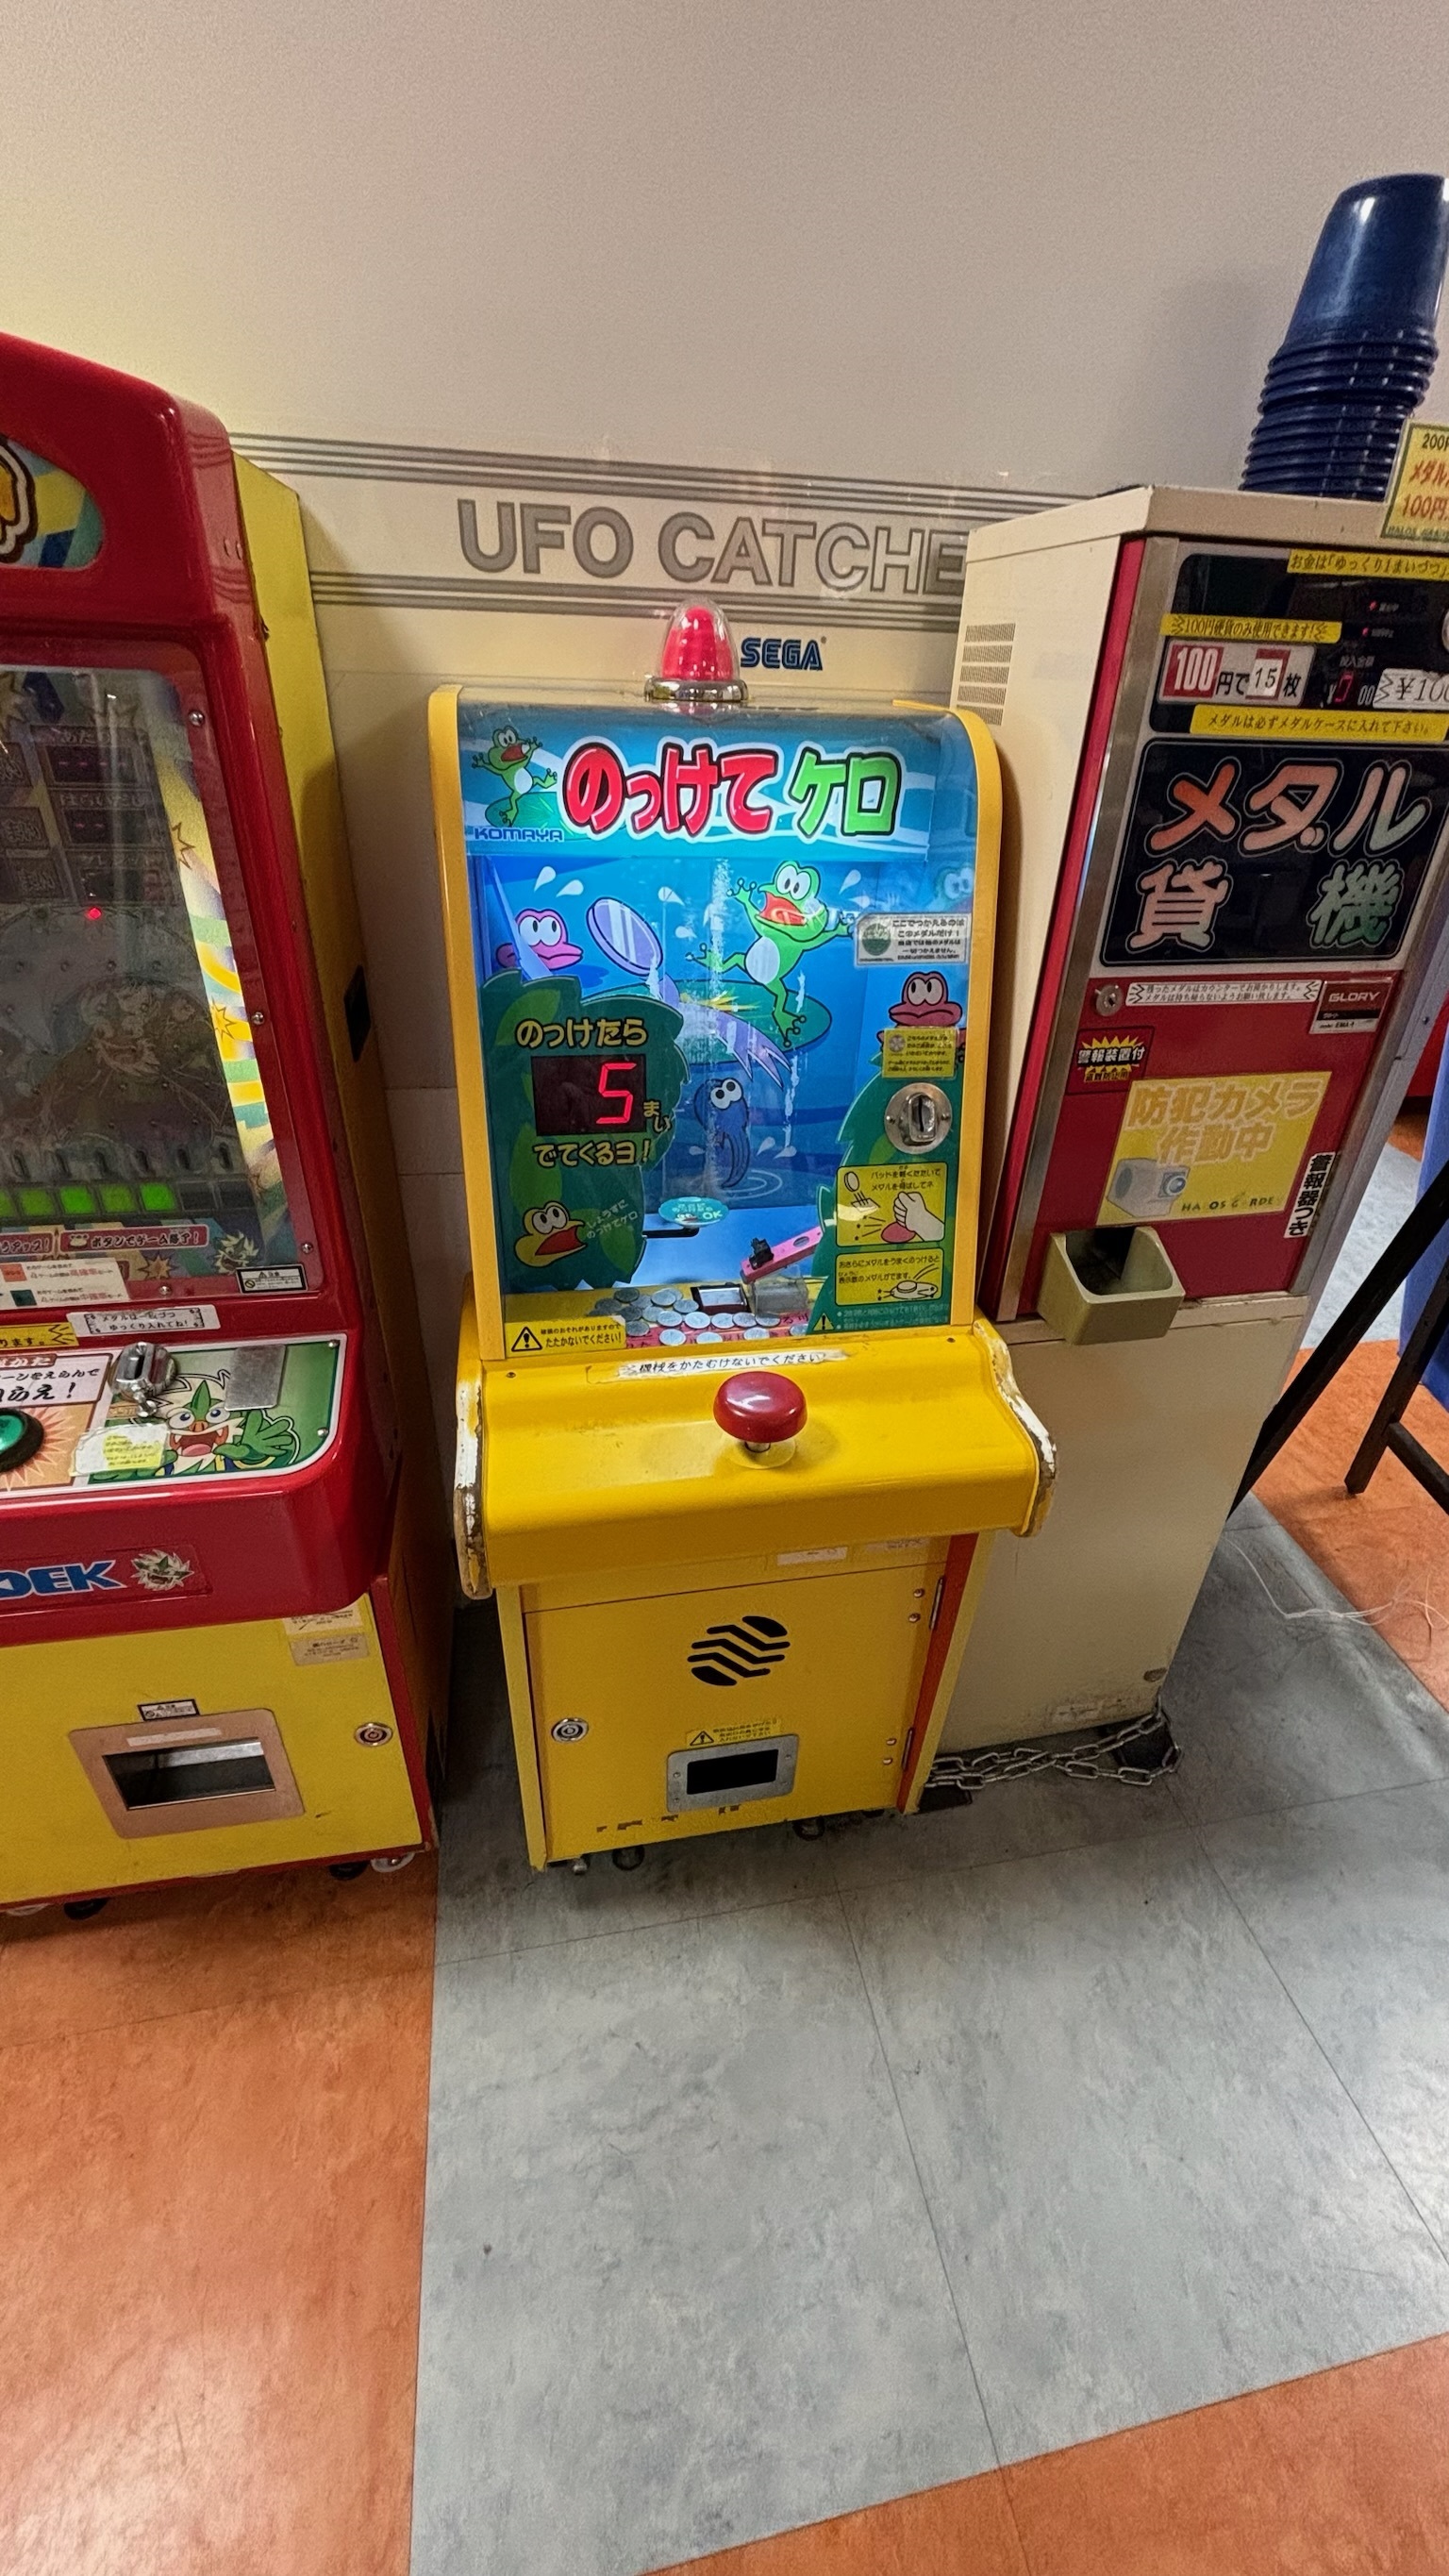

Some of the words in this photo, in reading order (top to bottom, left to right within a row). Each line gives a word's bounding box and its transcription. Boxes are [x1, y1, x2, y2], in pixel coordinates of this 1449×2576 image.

[1423, 432, 1449, 450] 200
[1409, 459, 1449, 485] メダル
[1401, 493, 1449, 522] 100円
[458, 498, 634, 578] UFO
[741, 637, 824, 671] SEGA
[565, 742, 777, 835] のっけて
[789, 746, 902, 837] ケロ
[1149, 762, 1429, 852] メダル
[475, 827, 564, 844] KOMAYA
[1130, 861, 1230, 948] 貸
[1310, 862, 1402, 945] 機
[1328, 992, 1380, 1002] GLORY
[516, 1018, 648, 1048] のっけたら
[596, 1062, 637, 1124] 5
[1125, 1079, 1323, 1129] 防犯カメラ
[1158, 1124, 1274, 1164] 作動中
[702, 1211, 723, 1220] OK
